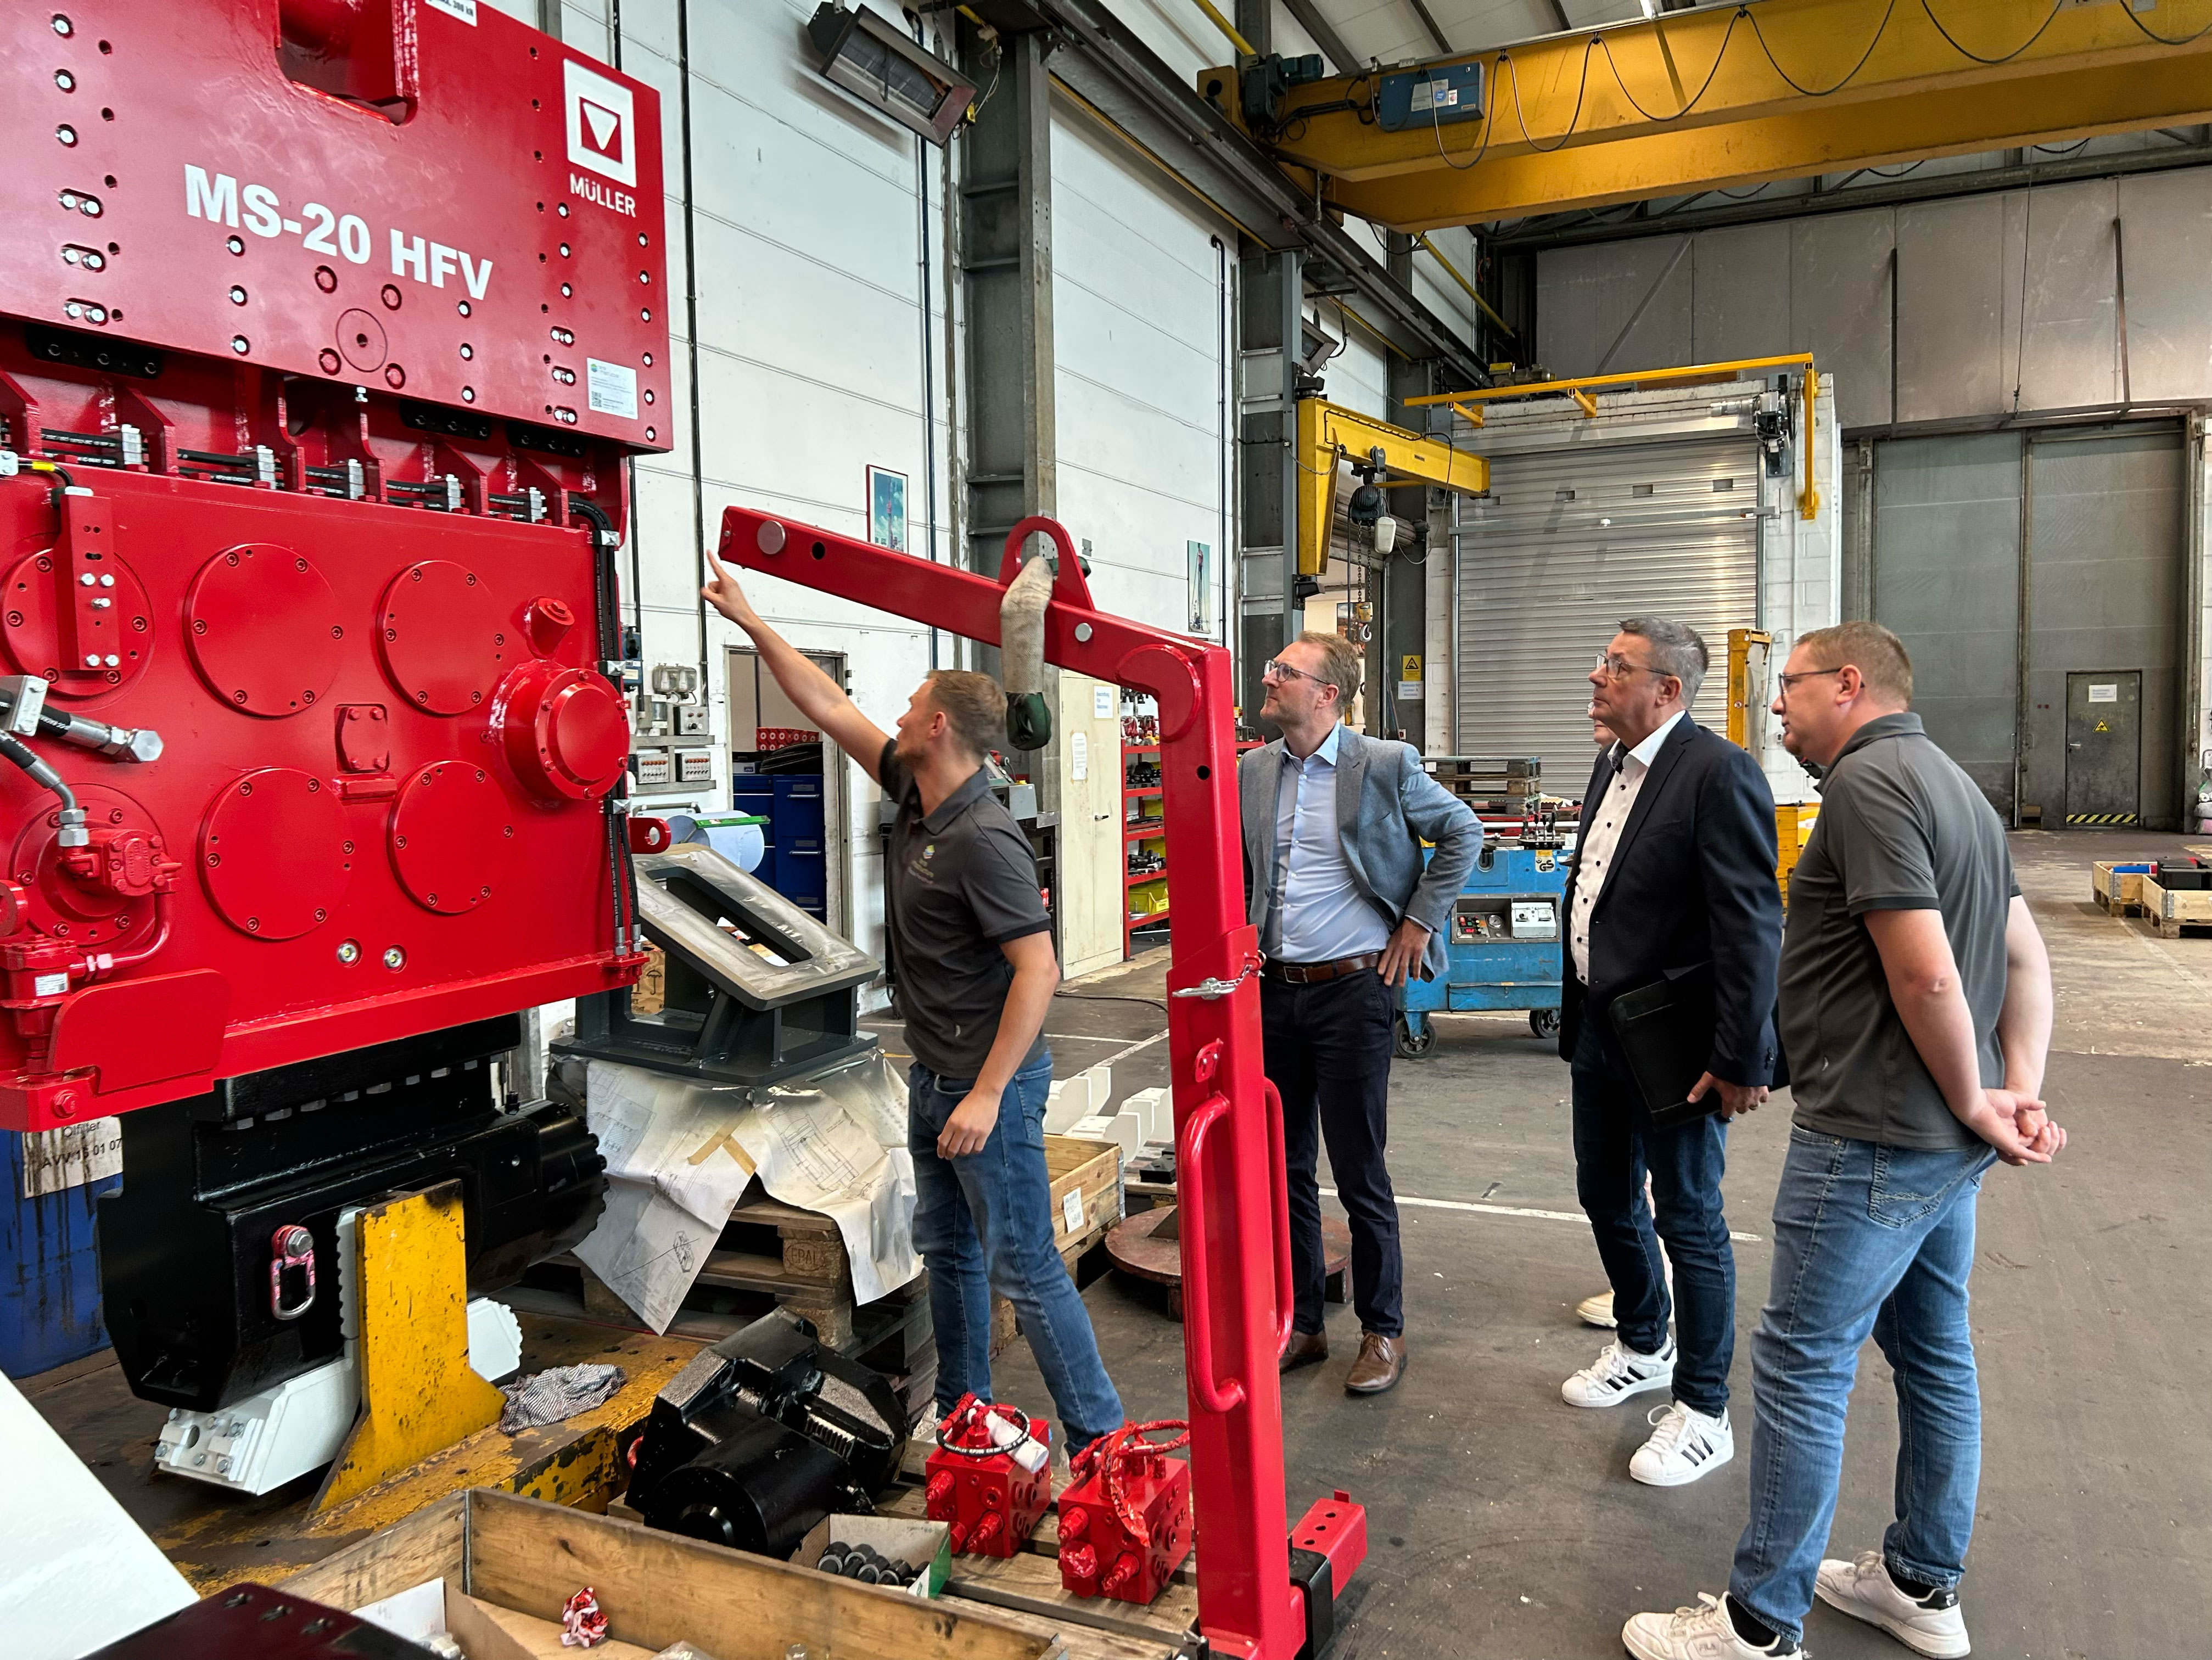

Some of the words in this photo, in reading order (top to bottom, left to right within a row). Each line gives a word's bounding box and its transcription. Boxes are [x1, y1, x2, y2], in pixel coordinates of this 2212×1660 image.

[570, 173, 636, 218] MÜLLER
[184, 164, 371, 264] MS-20
[390, 228, 493, 300] HFV
[93, 1143, 105, 1156] 01
[109, 1137, 122, 1151] 07
